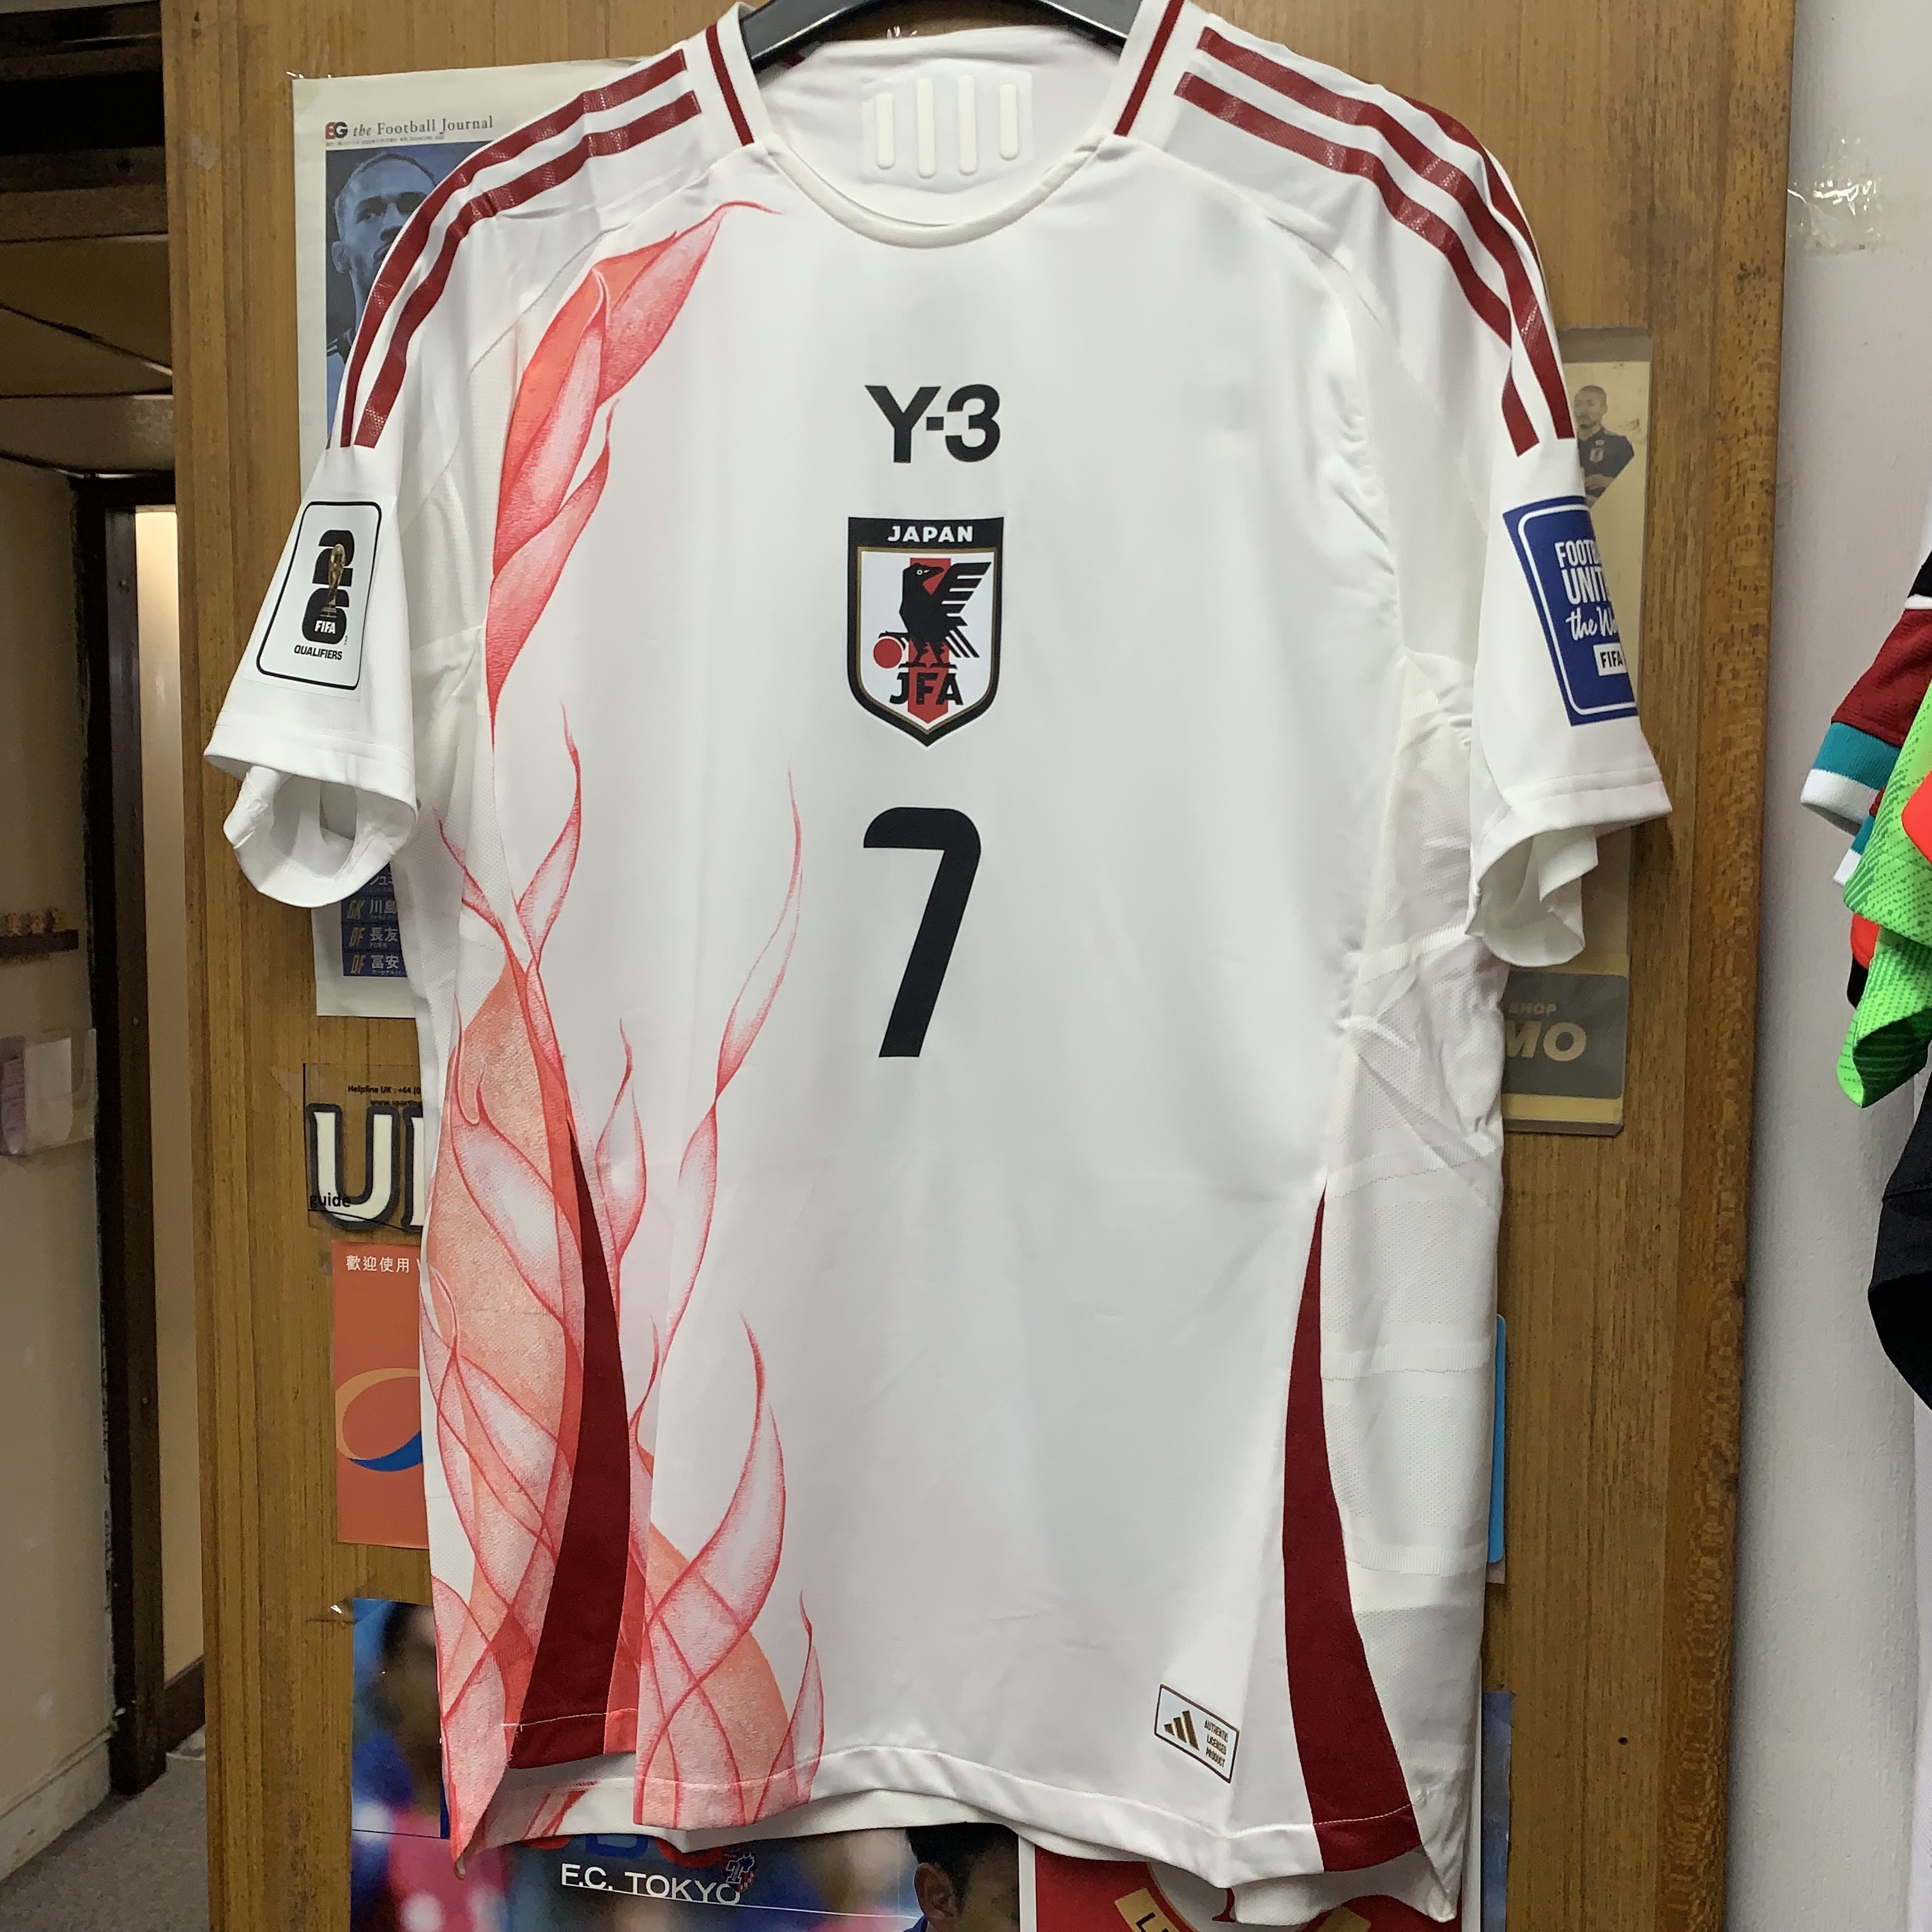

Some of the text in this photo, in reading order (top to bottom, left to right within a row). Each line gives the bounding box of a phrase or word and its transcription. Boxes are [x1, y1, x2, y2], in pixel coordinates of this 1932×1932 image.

[353, 124, 371, 137] the
[377, 119, 436, 135] Football
[439, 116, 493, 134] Journal
[864, 383, 1000, 463] Y-3
[887, 526, 973, 543] JAPAN
[1561, 566, 1611, 604] UNIT
[314, 620, 336, 634] FIFA
[1565, 607, 1597, 641] the
[294, 645, 342, 660] QUALIFIERS
[889, 673, 963, 705] JFA
[369, 926, 398, 942] 長友
[863, 807, 981, 1057] 7
[309, 1193, 351, 1209] guide
[346, 1255, 410, 1273] 歡迎使用
[625, 1871, 740, 1905] TOKYO
